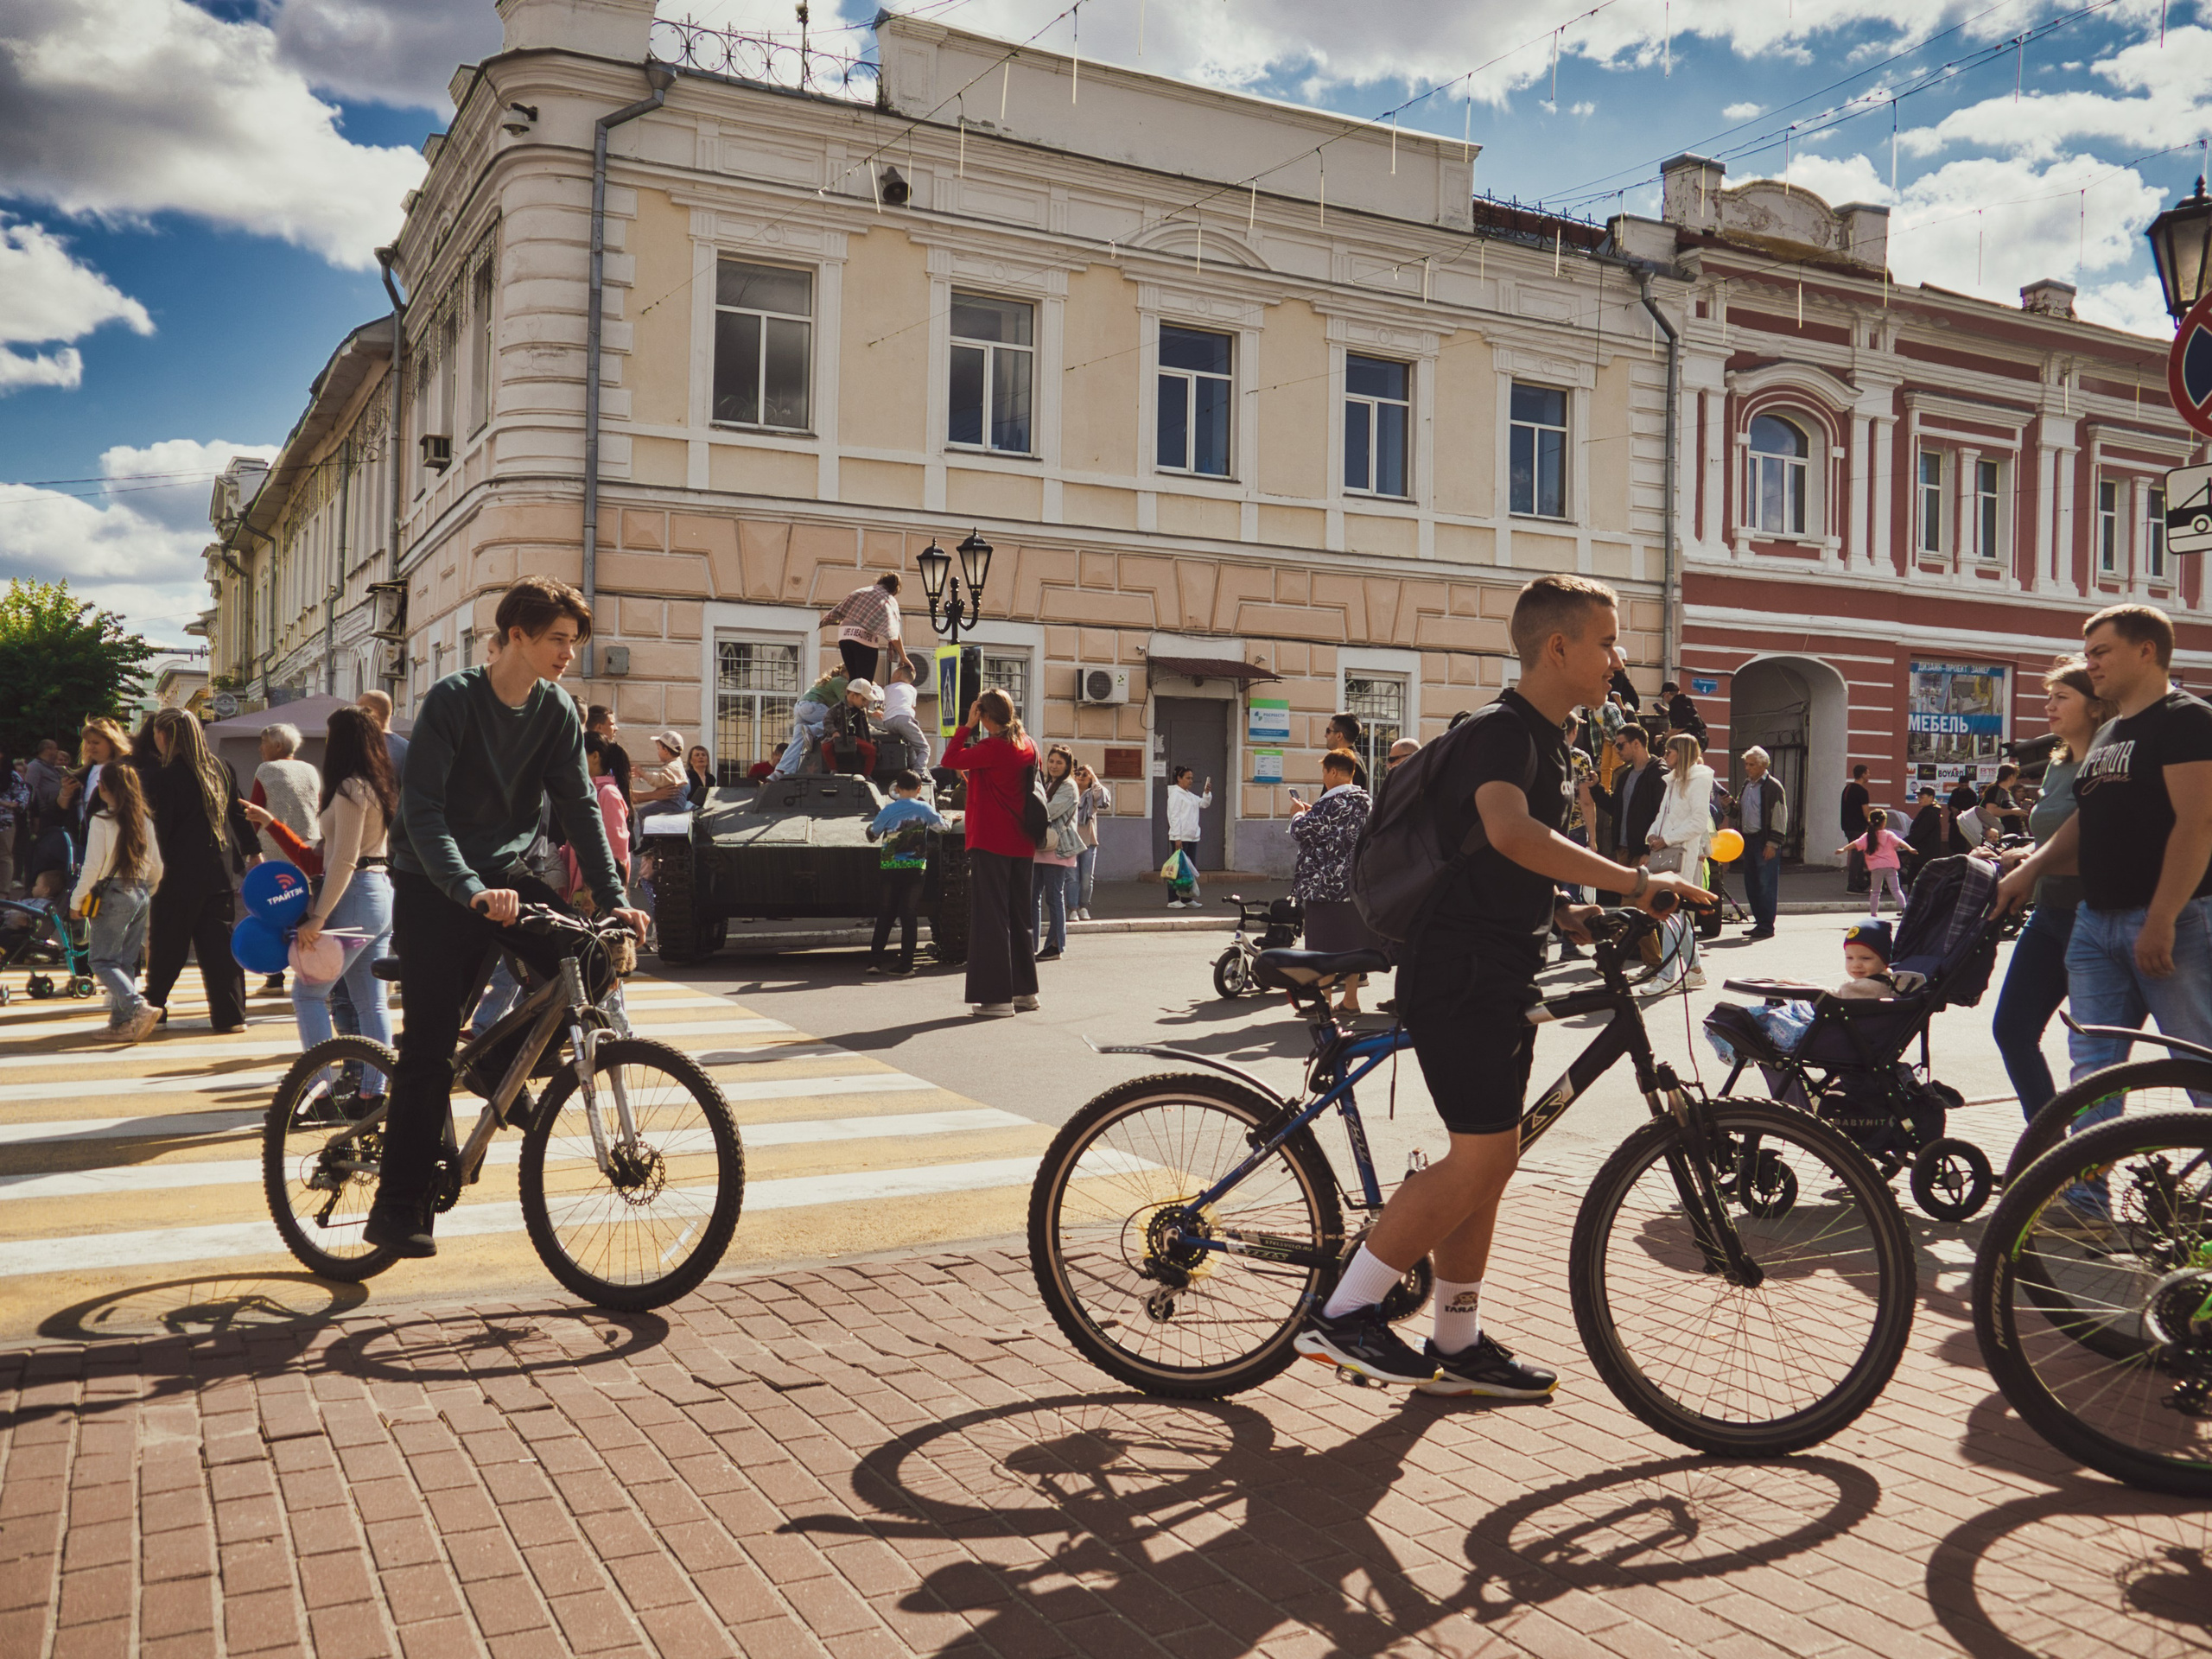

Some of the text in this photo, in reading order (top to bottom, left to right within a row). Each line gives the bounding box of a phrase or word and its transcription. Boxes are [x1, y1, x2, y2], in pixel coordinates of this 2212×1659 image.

[1702, 685, 1707, 694] 4
[1908, 714, 1969, 734] МЕБЕЛЬ
[2075, 740, 2136, 779] UPERIOR
[267, 886, 304, 906] ТРАЙТЭК
[1834, 1118, 1885, 1127] BABYHIT
[1265, 1239, 1313, 1252] STELSVELO.RU
[1992, 1252, 2009, 1350] MERIDA
